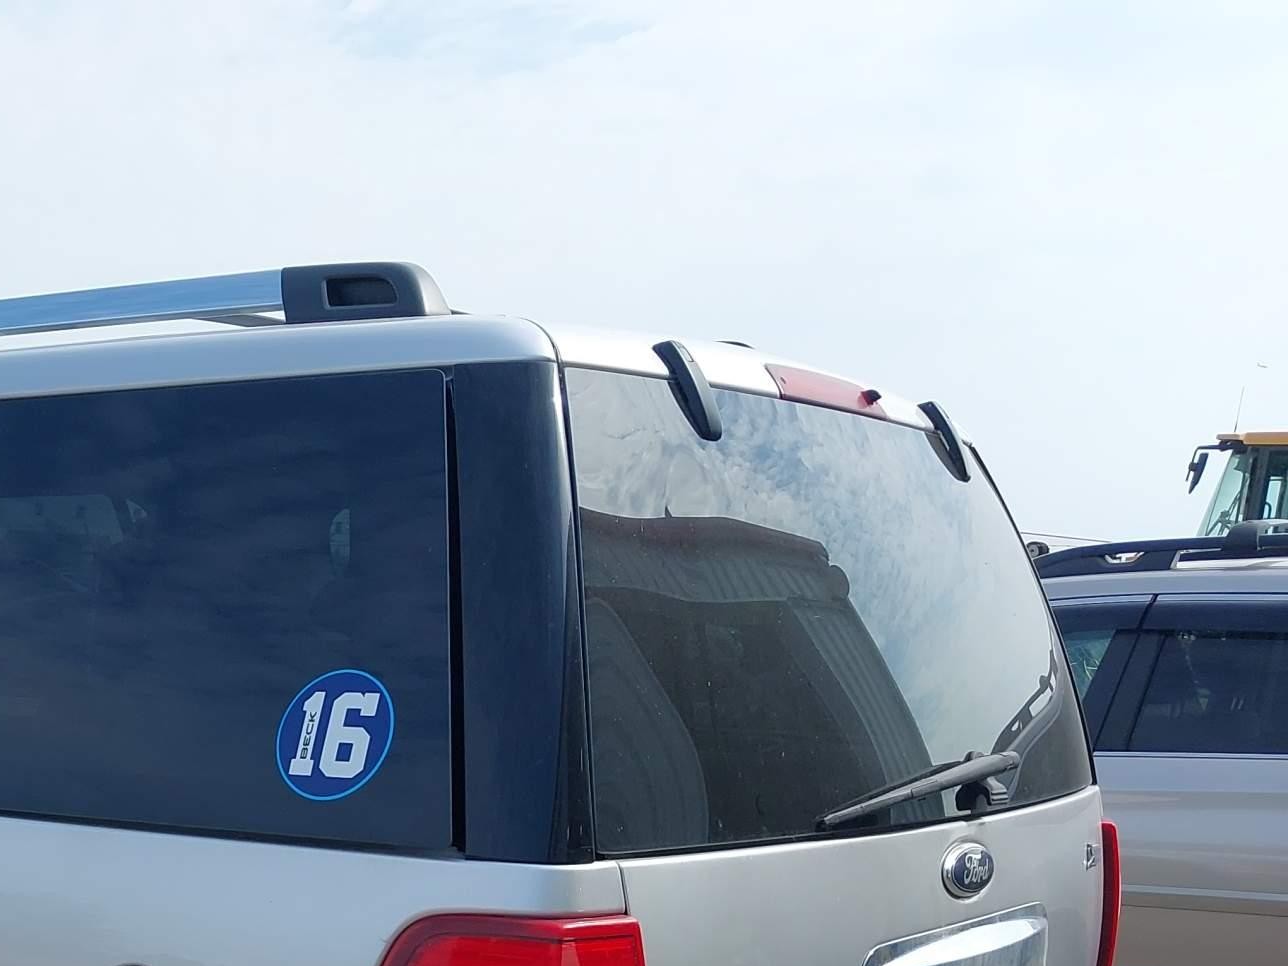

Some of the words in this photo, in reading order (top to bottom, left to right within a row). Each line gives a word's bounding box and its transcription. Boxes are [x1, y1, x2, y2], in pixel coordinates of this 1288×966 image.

[288, 691, 381, 779] 16
[299, 711, 317, 760] BECK
[963, 850, 990, 884] Ford
